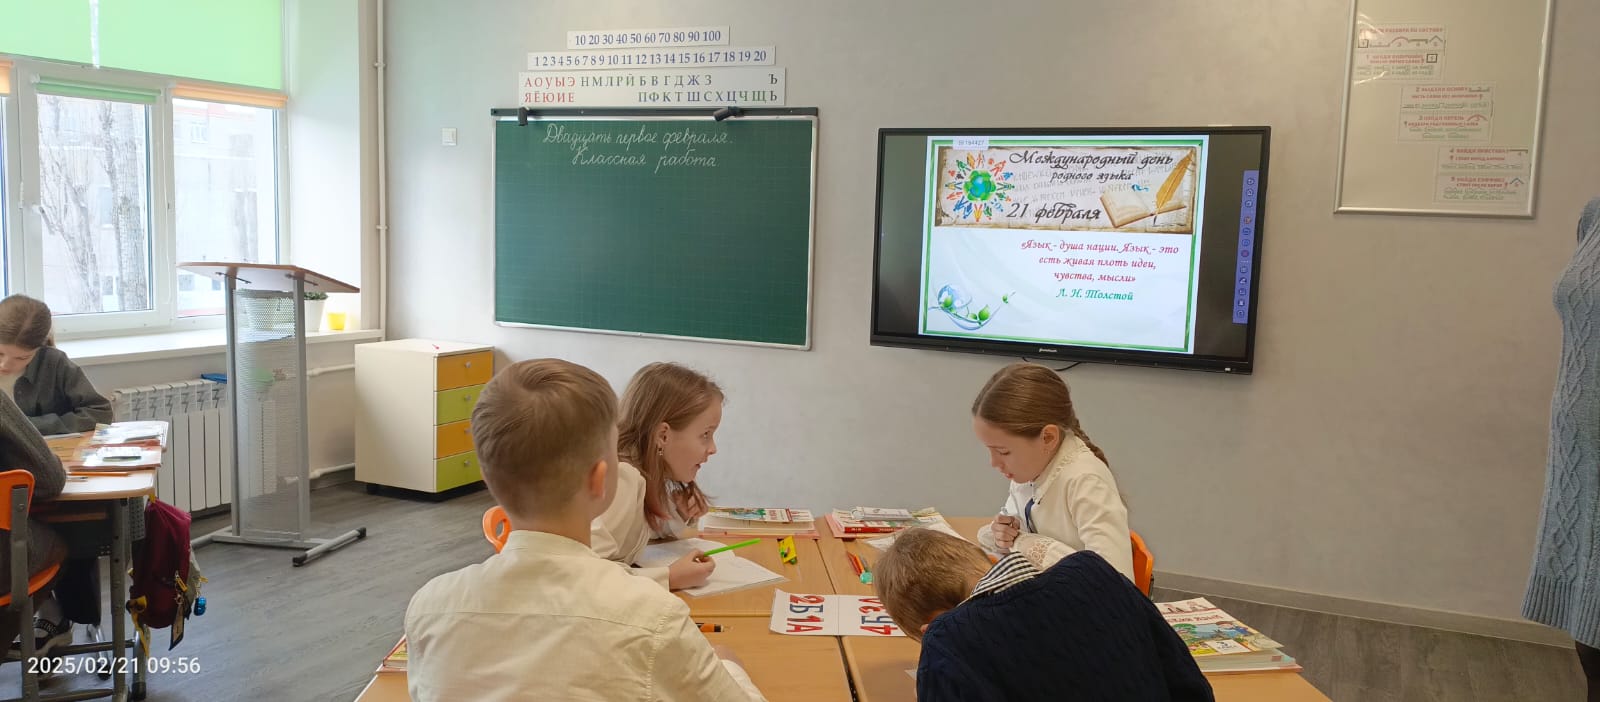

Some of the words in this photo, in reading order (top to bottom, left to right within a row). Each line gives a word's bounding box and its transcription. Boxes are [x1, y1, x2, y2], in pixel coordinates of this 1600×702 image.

[576, 35, 585, 45] 10
[588, 34, 599, 45] 20
[602, 33, 613, 44] 30
[615, 33, 627, 44] 40
[630, 33, 641, 43] 50
[644, 32, 655, 43] 60
[658, 32, 670, 42] 70
[673, 31, 684, 42] 80
[687, 30, 699, 41] 90
[703, 30, 720, 41] 100
[535, 56, 539, 66] 1
[542, 56, 548, 66] 2
[550, 56, 556, 65] 3
[558, 56, 563, 66] 4
[566, 55, 572, 65] 5
[574, 55, 580, 65] 6
[582, 55, 588, 65] 7
[590, 55, 596, 65] 8
[598, 55, 605, 65] 9
[608, 54, 618, 65] 10
[622, 54, 632, 64] 11
[636, 54, 647, 64] 12
[650, 53, 661, 64] 13
[663, 53, 675, 63] 14
[679, 53, 690, 63] 15
[694, 52, 705, 63] 16
[708, 51, 720, 62] 17
[724, 51, 735, 62] 18
[739, 51, 750, 61] 19
[753, 50, 766, 61] 20
[543, 123, 611, 150] Двадцать
[616, 125, 657, 151] первое
[572, 146, 646, 166] Классная
[1009, 150, 1139, 170] Международный
[1140, 155, 1174, 171] день
[1050, 170, 1093, 183] родного
[1097, 171, 1134, 183] языка
[1006, 202, 1028, 219] 21
[1034, 202, 1102, 224] февраля
[1021, 240, 1052, 251] «Язык
[1059, 240, 1084, 252] душа
[1086, 244, 1119, 255] нации.
[1119, 243, 1151, 255] Язык
[1158, 246, 1179, 254] это
[1039, 256, 1061, 265] есть
[1063, 257, 1094, 267] живая
[1097, 258, 1129, 267] плоть
[1054, 271, 1095, 283] чувства,
[1097, 272, 1136, 283] мысли»
[1056, 288, 1068, 298] Л.
[1071, 288, 1082, 299] Н.
[1085, 290, 1134, 301] Толстой
